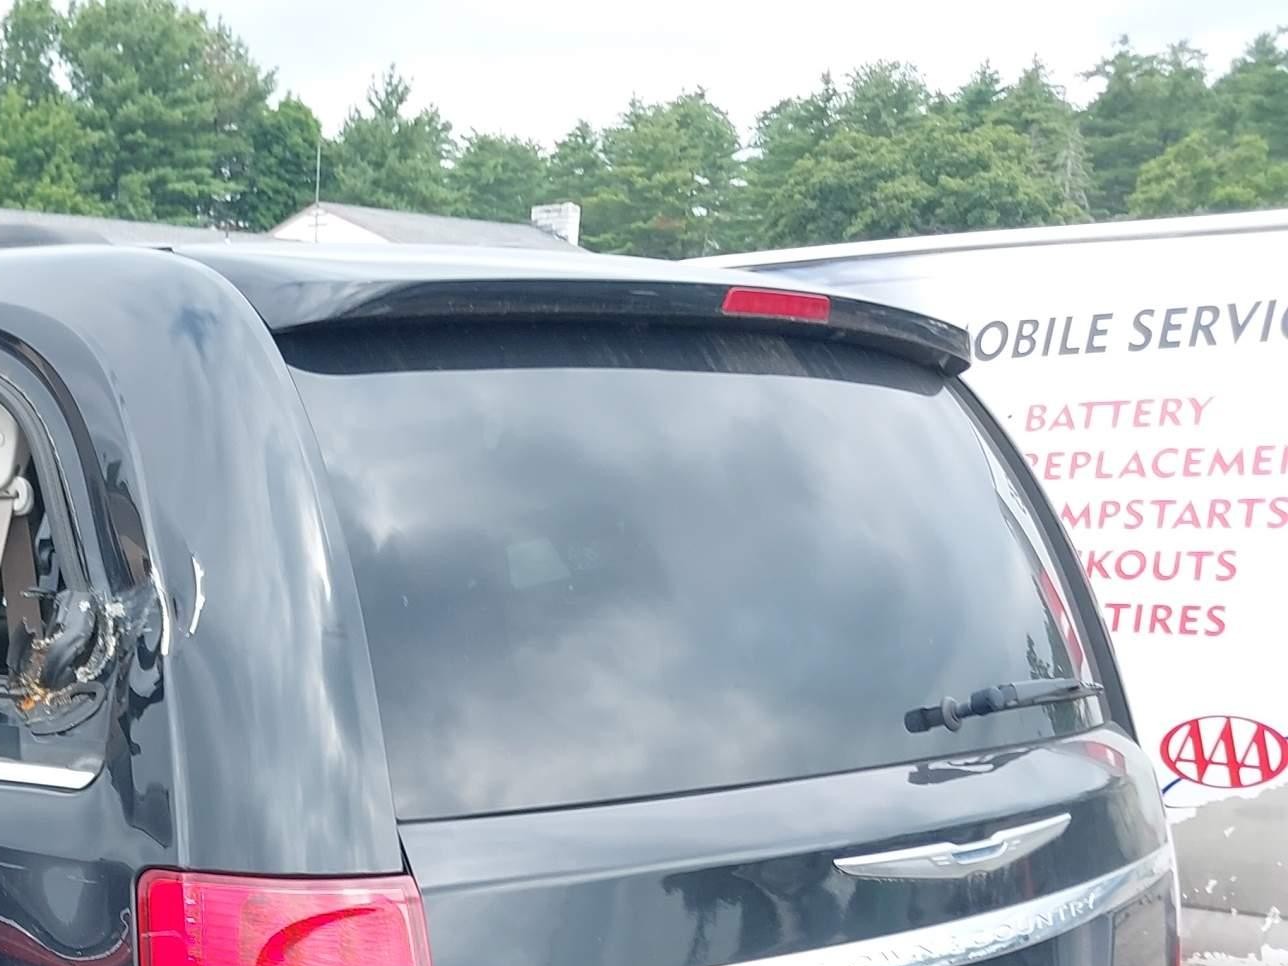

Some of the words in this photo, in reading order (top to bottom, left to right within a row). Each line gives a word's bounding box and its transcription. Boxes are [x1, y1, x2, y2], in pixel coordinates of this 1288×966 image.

[969, 312, 1113, 362] OBILE
[1127, 299, 1288, 353] SERVI
[1024, 396, 1215, 433] BATTERY
[1025, 445, 1288, 481] EPLACEME
[1078, 549, 1237, 582] KOUTS
[1104, 603, 1227, 637] TIRES
[1173, 715, 1282, 789] AAA
